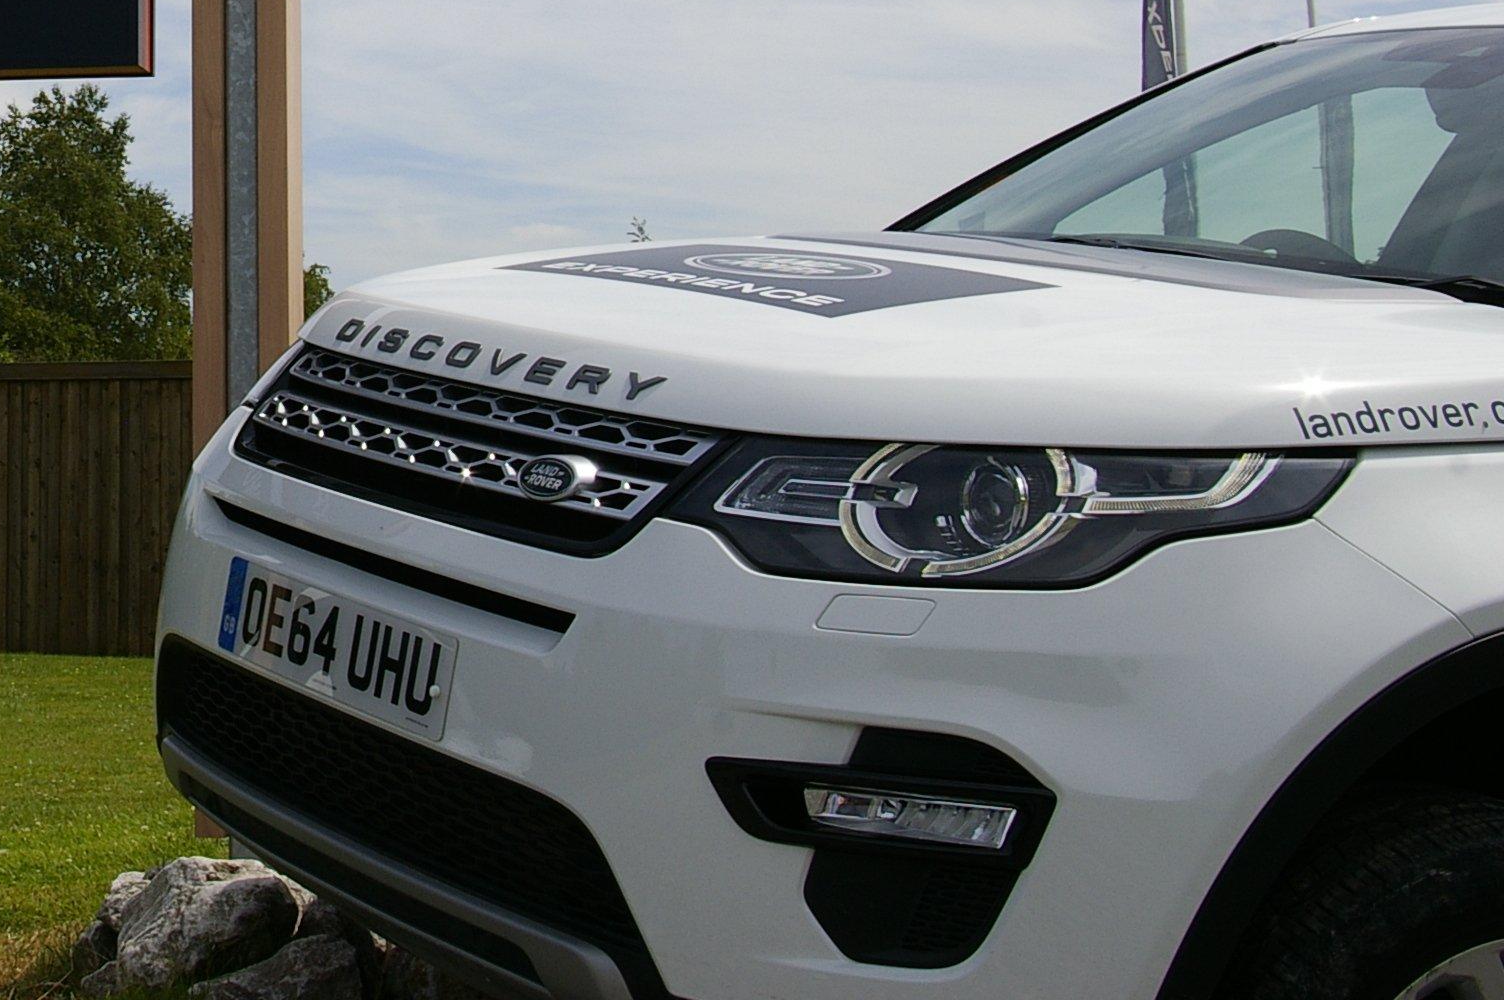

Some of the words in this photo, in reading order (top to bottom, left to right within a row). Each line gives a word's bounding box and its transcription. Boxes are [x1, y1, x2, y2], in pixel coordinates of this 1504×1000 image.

[541, 260, 846, 307] EXPERIENCE
[334, 317, 668, 401] DISCOVERY
[527, 473, 564, 490] ROVER
[530, 463, 559, 477] LAND
[223, 613, 235, 635] GB
[242, 576, 340, 677] OE64
[347, 613, 442, 716] UHU
